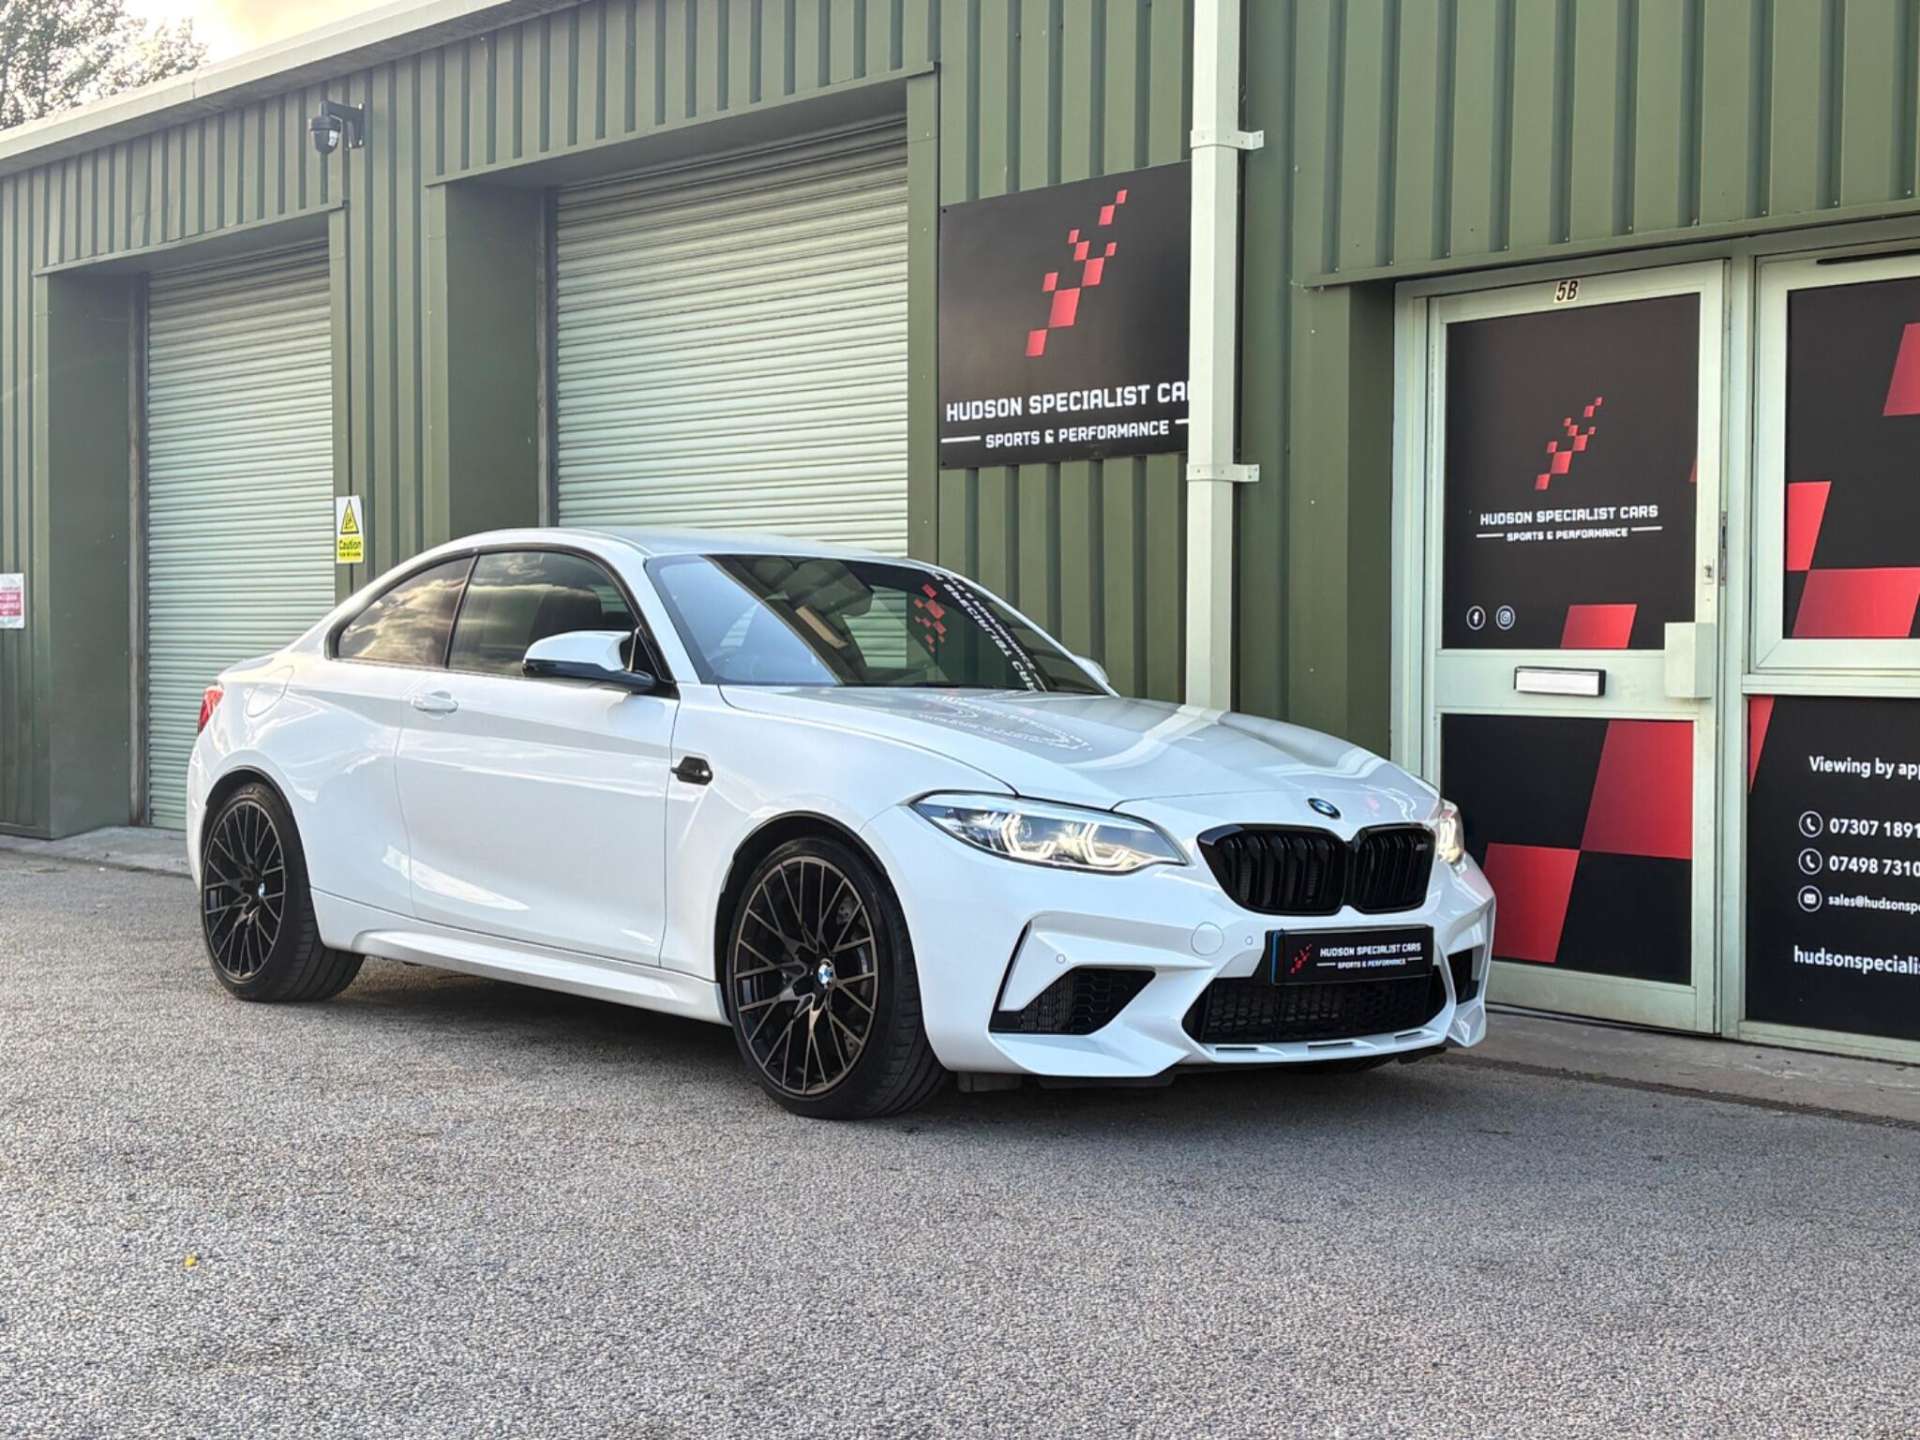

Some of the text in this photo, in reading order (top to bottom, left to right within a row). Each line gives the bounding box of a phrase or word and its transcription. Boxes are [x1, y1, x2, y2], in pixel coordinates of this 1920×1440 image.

[1557, 281, 1578, 301] 5B
[946, 381, 1190, 422] HUDSON SPECIALIST CA
[986, 420, 1169, 448] SPORTS & PERFORMANCE
[1480, 505, 1658, 525] HUDSON SPECIALIST CARS
[1507, 528, 1628, 542] SPORTS & PERFORMANCE
[1809, 756, 1920, 780] Viewing by ap
[1830, 818, 1920, 838] 07307 1891
[1829, 856, 1920, 877] 07498 7310
[1828, 894, 1920, 914] sales@hudsonsp
[1320, 943, 1421, 957] HUDSON SPECIALIST CARS
[1794, 945, 1920, 974] hudsonspeciali
